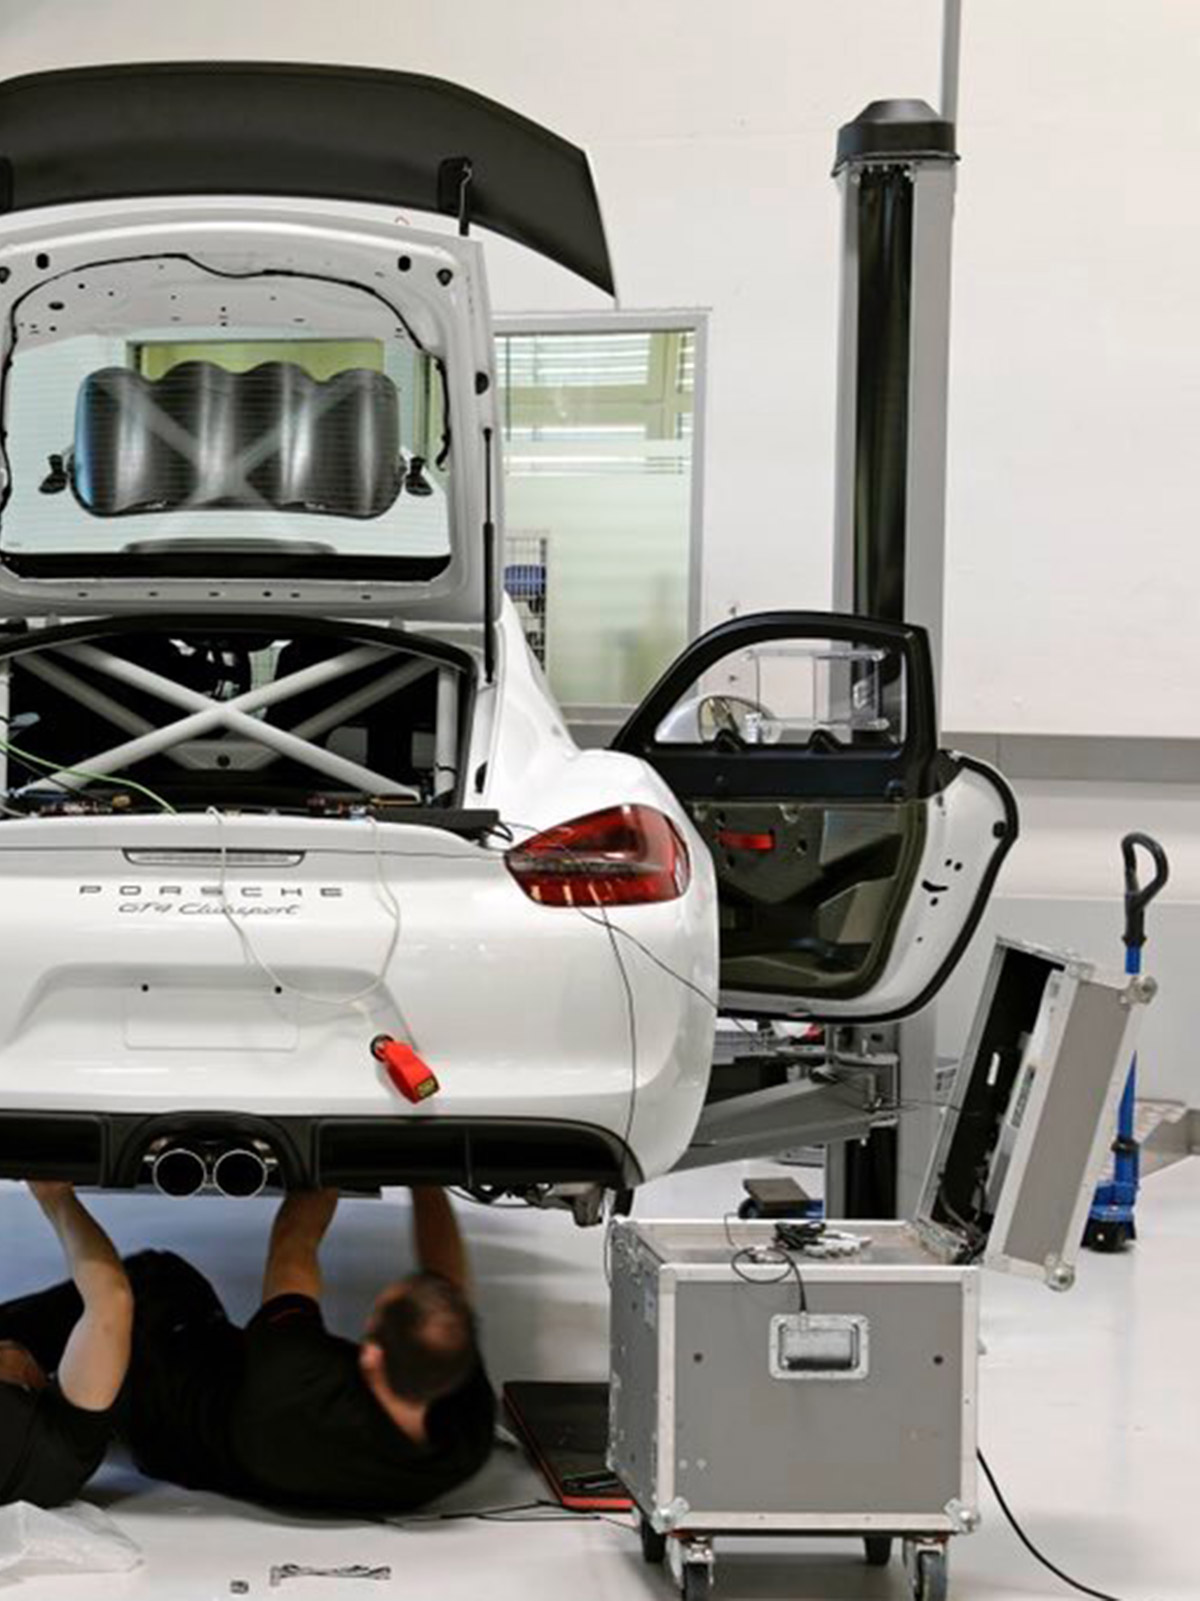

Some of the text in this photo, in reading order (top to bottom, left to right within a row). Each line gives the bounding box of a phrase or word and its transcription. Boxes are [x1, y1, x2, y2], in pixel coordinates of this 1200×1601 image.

[79, 885, 343, 898] PORSCHE
[118, 902, 300, 918] GT4 Clubsport
